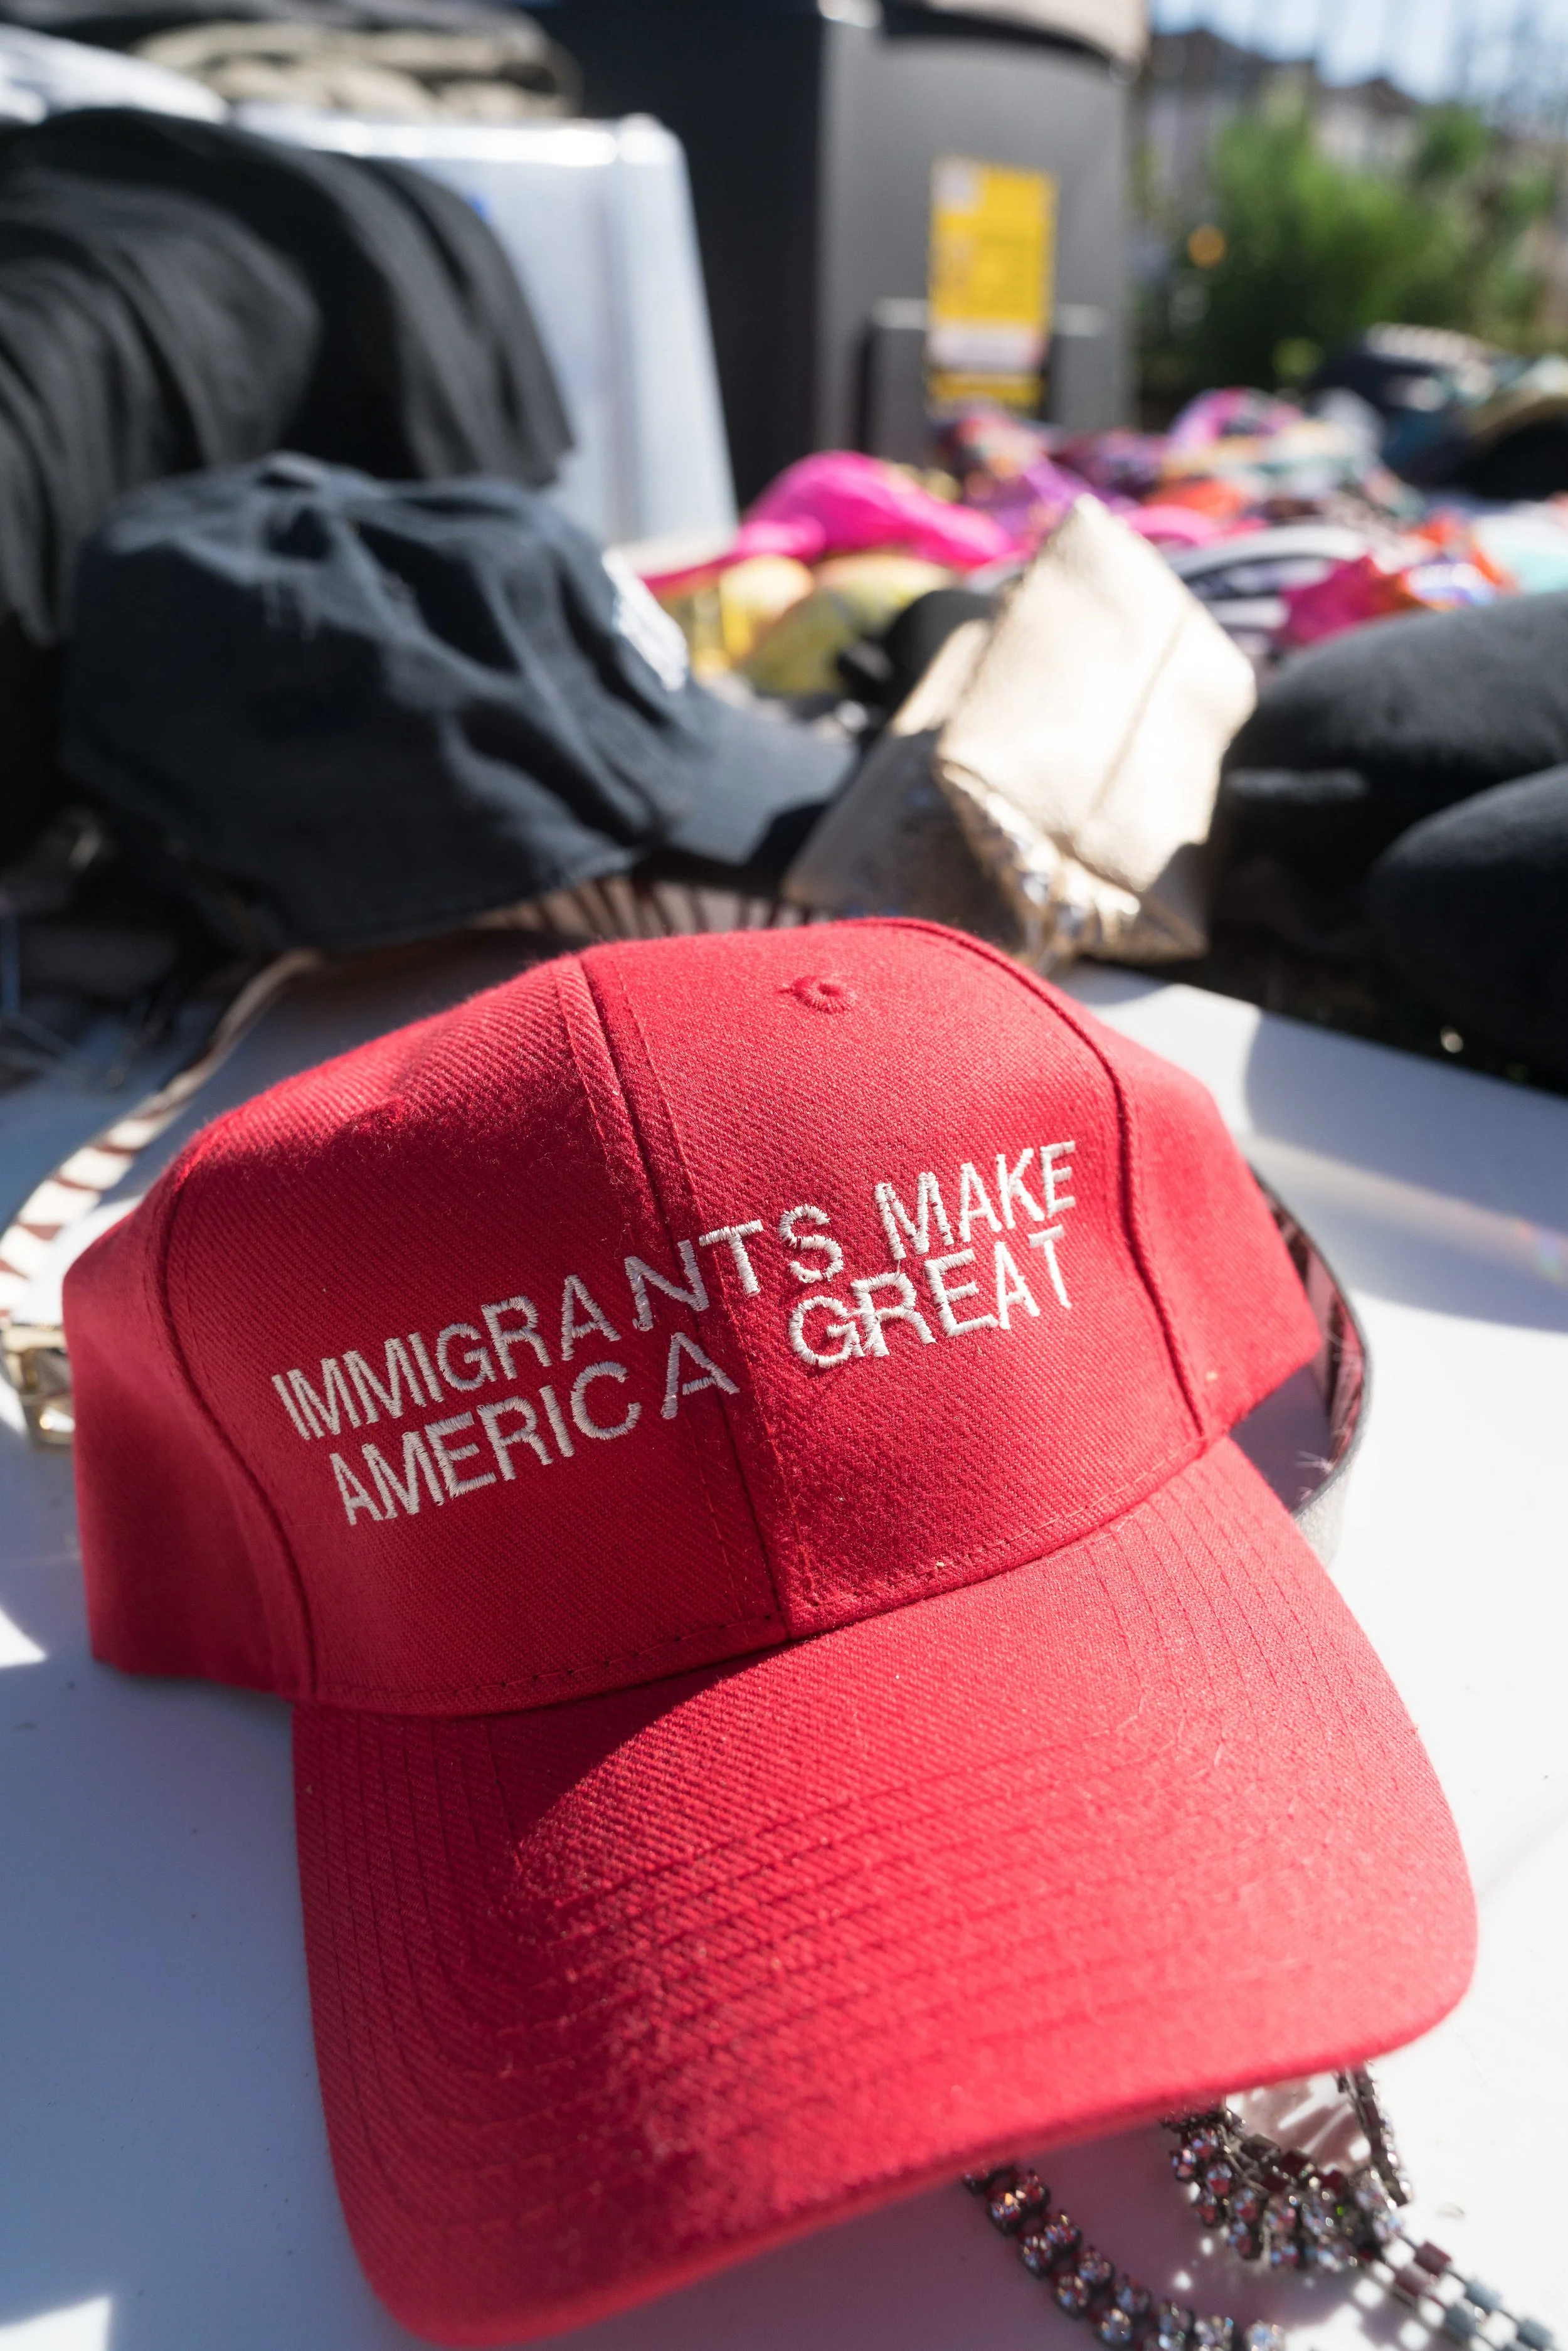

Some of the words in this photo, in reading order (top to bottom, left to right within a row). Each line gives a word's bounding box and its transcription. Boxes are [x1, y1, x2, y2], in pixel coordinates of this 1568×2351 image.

[272, 1204, 842, 1440] IMMIGRANTS
[874, 1141, 1076, 1261] MAKE
[329, 1332, 739, 1525] AMERICA
[788, 1225, 1071, 1369] GREAT
